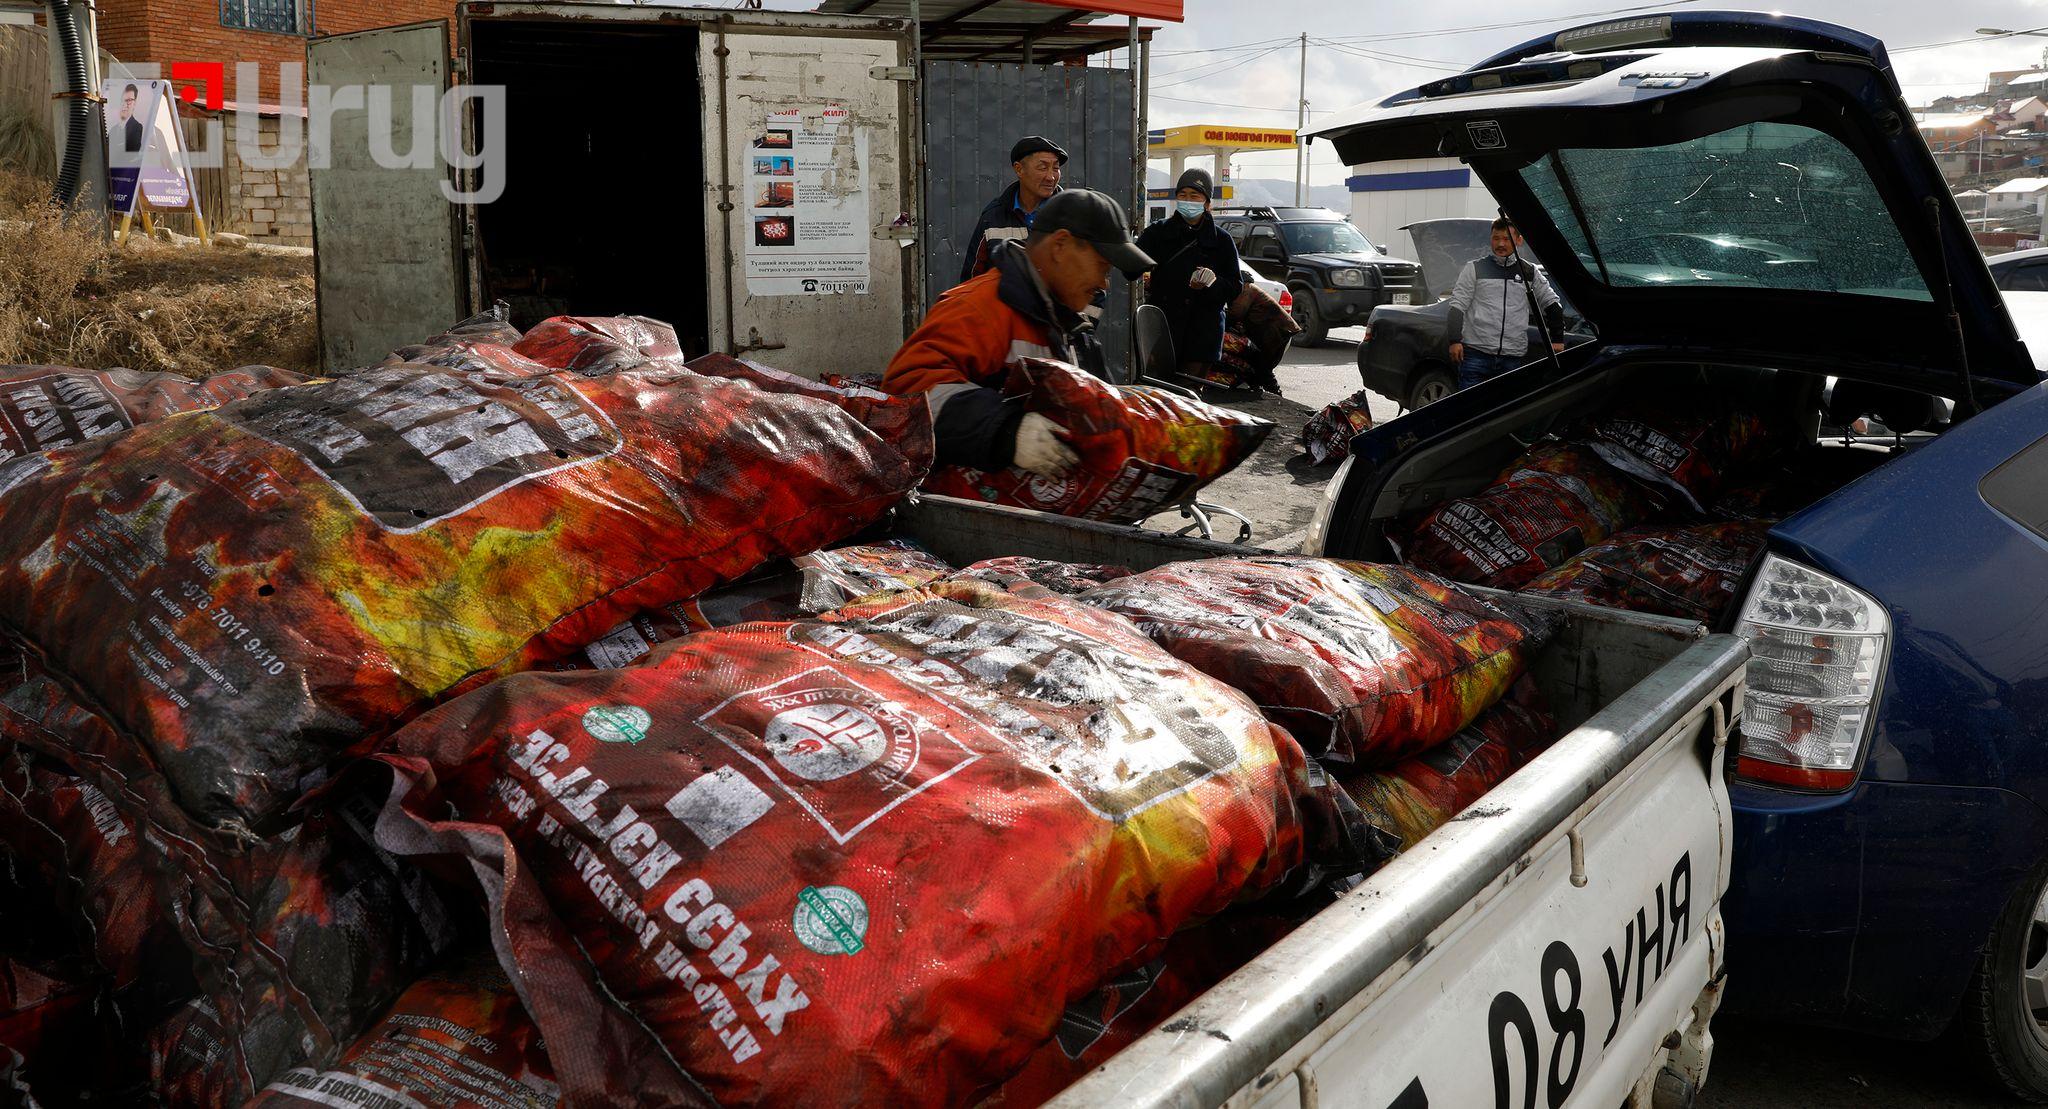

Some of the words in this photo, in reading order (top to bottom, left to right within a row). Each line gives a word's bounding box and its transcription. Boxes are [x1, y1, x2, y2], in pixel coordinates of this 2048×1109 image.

[820, 283, 865, 291] 7011900
[181, 579, 214, 611] +976
[663, 877, 811, 1037] ХҮЧЭЭ
[1602, 850, 1692, 1050] УНЯ
[654, 940, 763, 1065] АГААРЫН
[466, 1033, 499, 1055] ОРЦ:
